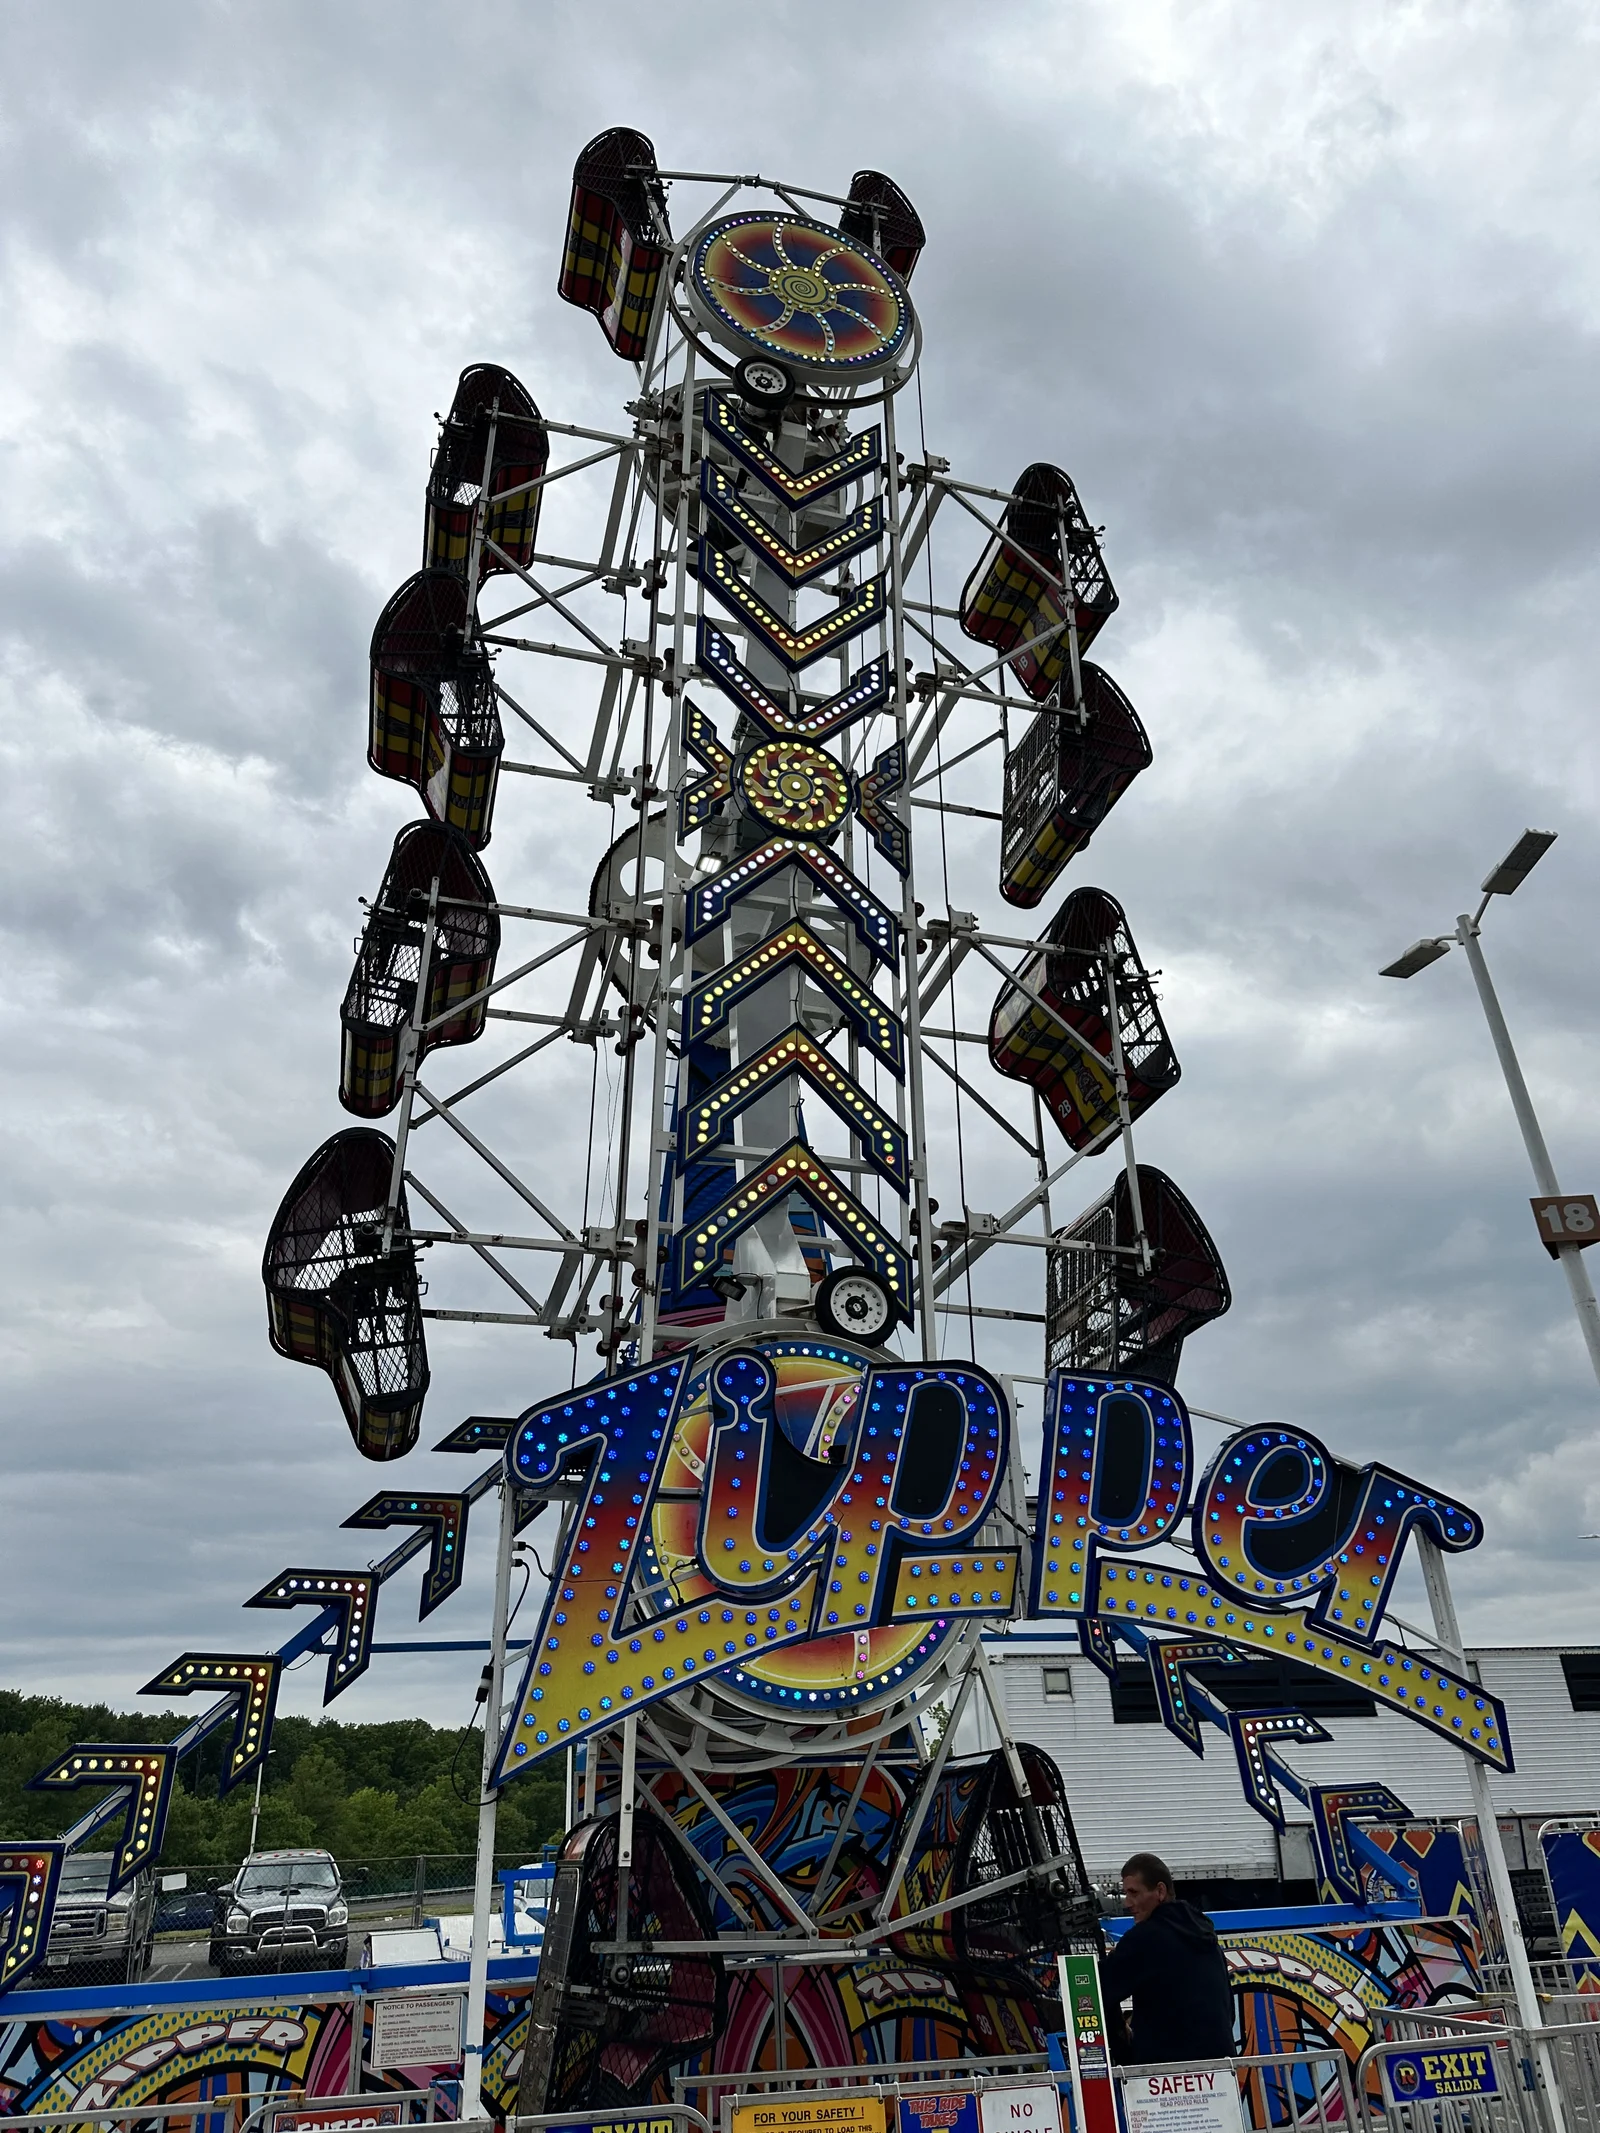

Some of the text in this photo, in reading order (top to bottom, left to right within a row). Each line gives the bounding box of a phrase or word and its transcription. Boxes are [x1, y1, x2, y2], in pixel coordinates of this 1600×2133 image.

[1058, 1099, 1072, 1119] 2B
[1540, 1203, 1595, 1233] 18
[1224, 1947, 1371, 2024] IPPER
[415, 2000, 454, 2008] PASSENGERS
[976, 2013, 993, 2036] 3B
[1077, 2015, 1099, 2028] YES
[1421, 2051, 1486, 2080] EXIT
[1148, 2073, 1215, 2096] SAFETY
[1435, 2078, 1482, 2095] SALIDA
[908, 2095, 967, 2115] THIS RIDE
[1010, 2103, 1033, 2118] NO
[754, 2112, 776, 2124] FOR
[781, 2110, 811, 2122] YOUR
[816, 2107, 856, 2119] SAFETY
[919, 2111, 958, 2129] TAKES
